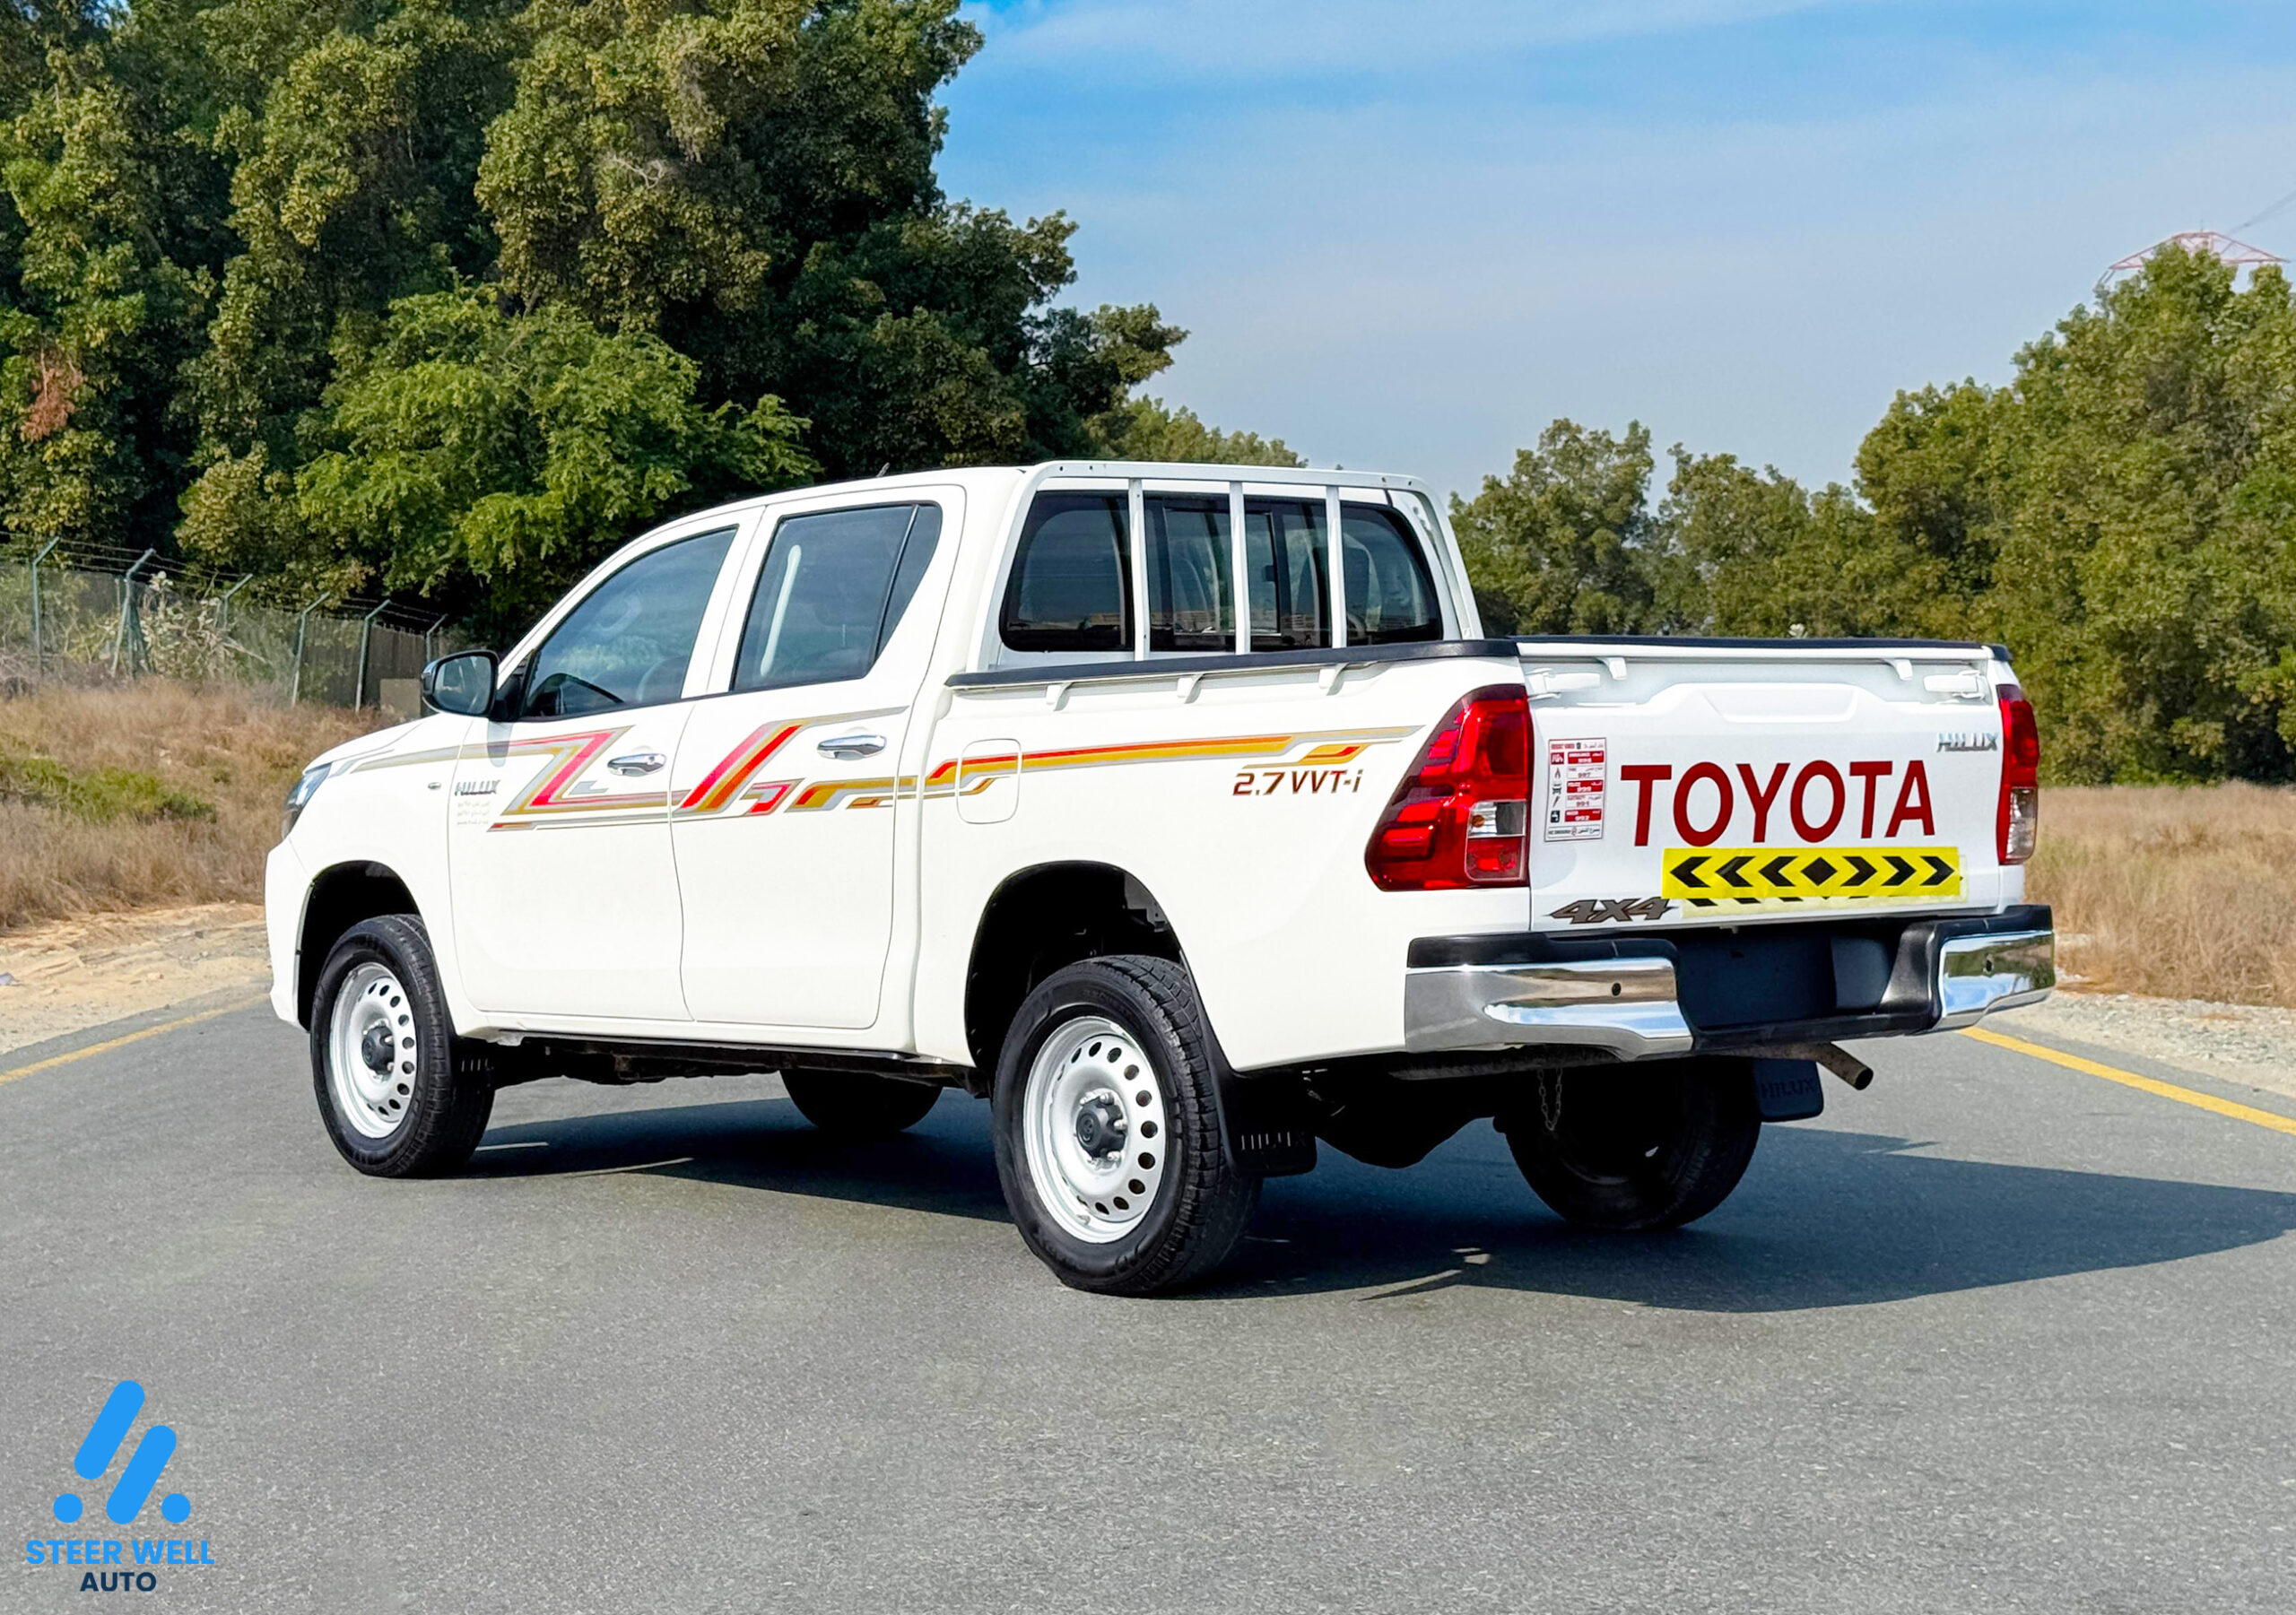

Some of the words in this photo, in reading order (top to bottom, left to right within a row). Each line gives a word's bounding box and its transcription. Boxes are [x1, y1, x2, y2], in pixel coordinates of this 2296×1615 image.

[1936, 732, 1999, 753] HILUX
[454, 779, 501, 796] HILUX
[1232, 771, 1285, 796] 2.7
[1291, 768, 1364, 794] VVT-i
[1620, 760, 1936, 847] TOYOTA
